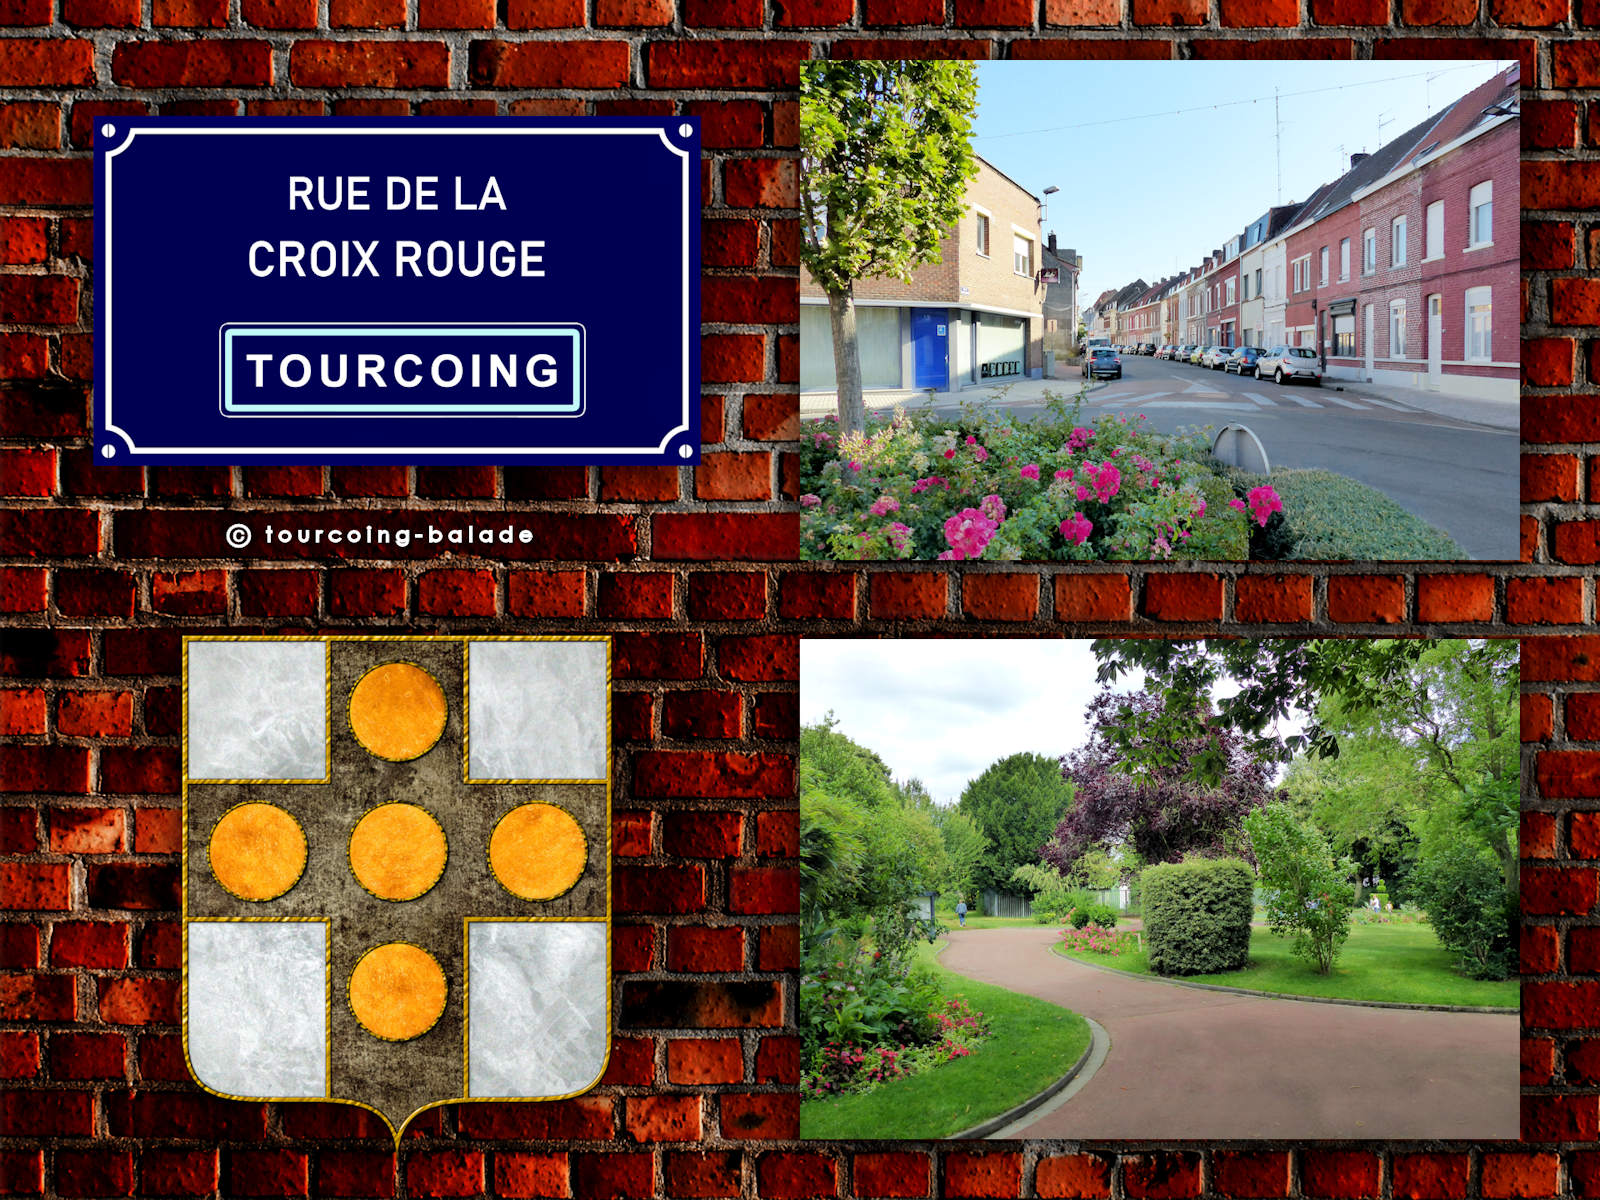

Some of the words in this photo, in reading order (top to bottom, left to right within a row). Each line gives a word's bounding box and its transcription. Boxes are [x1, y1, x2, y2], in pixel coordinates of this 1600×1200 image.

[290, 176, 370, 210] RUE
[387, 176, 438, 210] DE
[455, 176, 506, 210] LA
[249, 240, 379, 277] CROIX
[396, 240, 545, 277] ROUGE
[246, 354, 559, 387] TOURCOING
